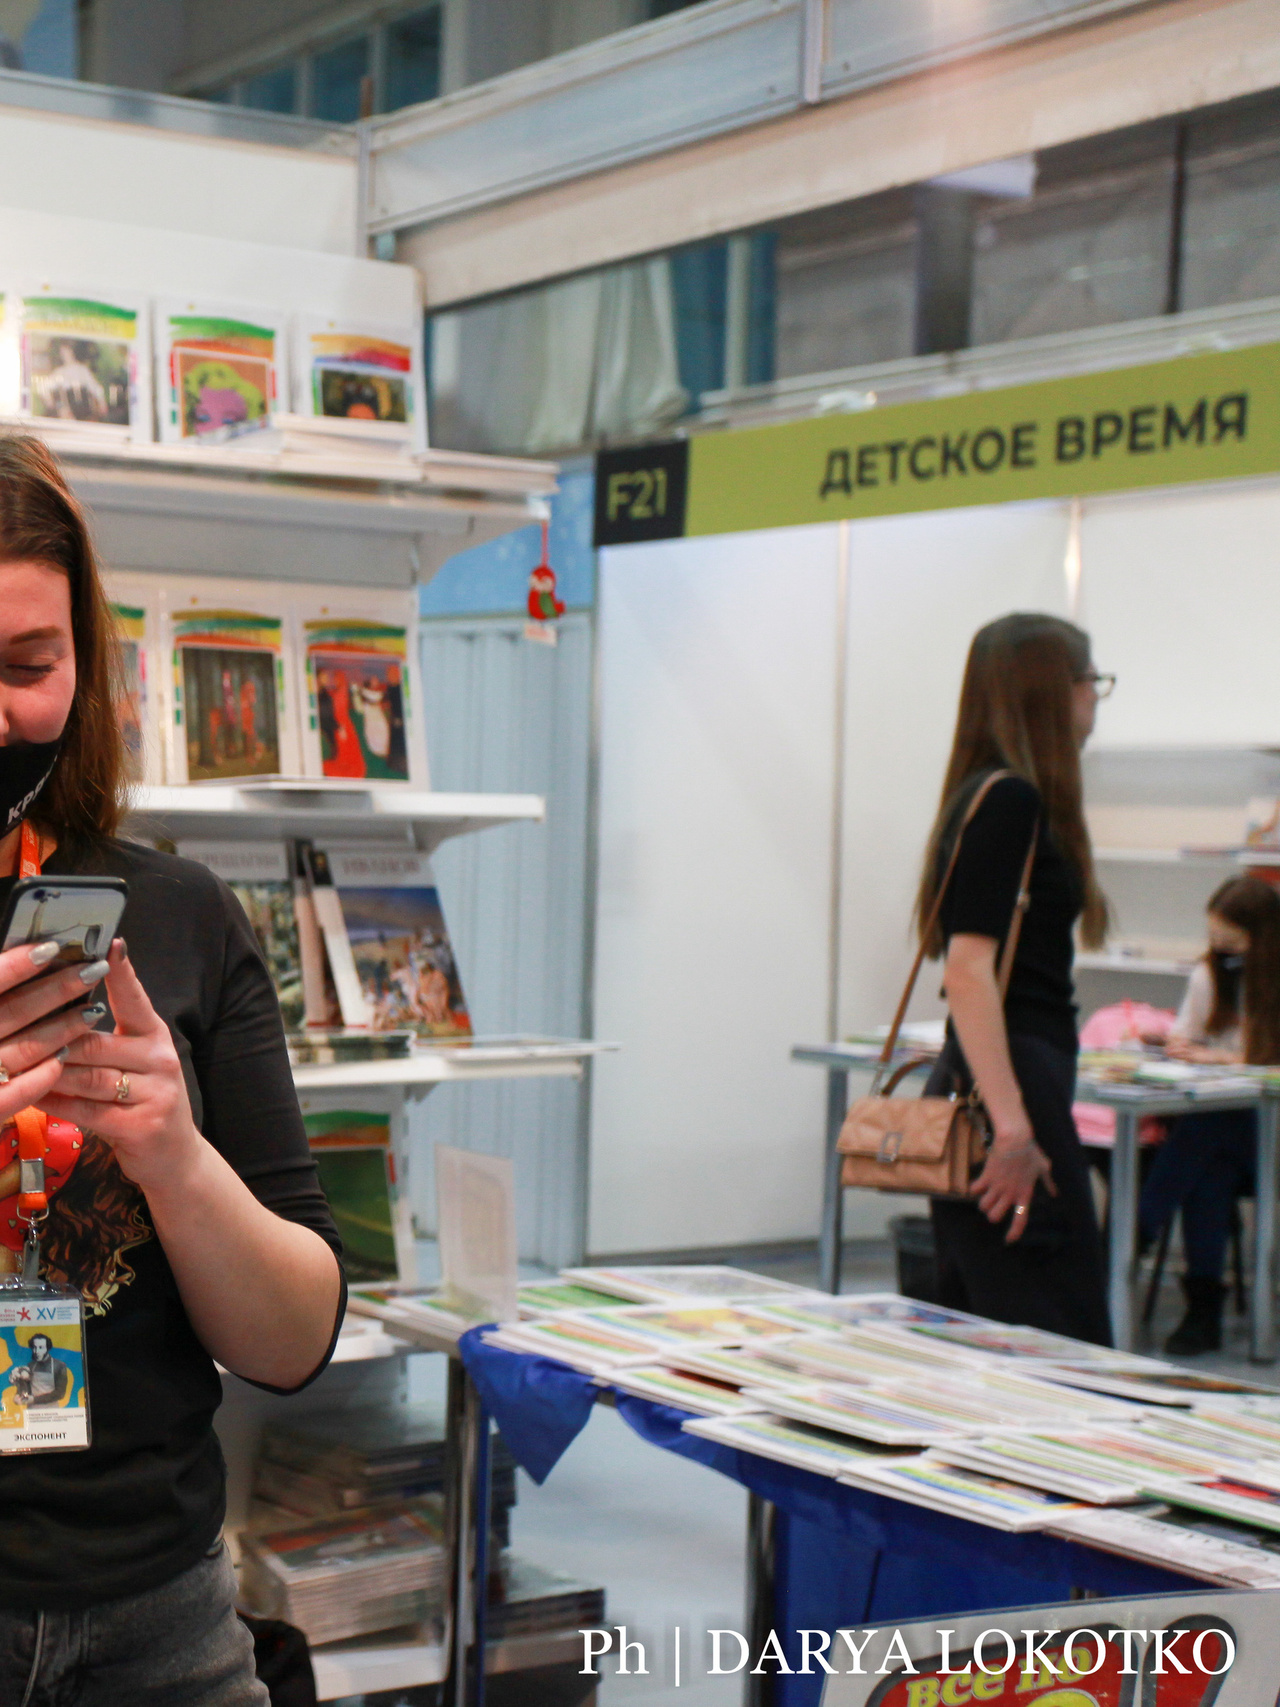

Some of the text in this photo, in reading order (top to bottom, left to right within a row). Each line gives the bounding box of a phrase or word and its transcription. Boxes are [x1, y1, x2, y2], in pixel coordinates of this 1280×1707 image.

[819, 392, 1249, 499] ДЕТСКОЕ ВРЕМЯ
[607, 467, 668, 520] F21
[36, 1307, 57, 1321] XV
[14, 1432, 68, 1442] ЭКСПОНЕНТ
